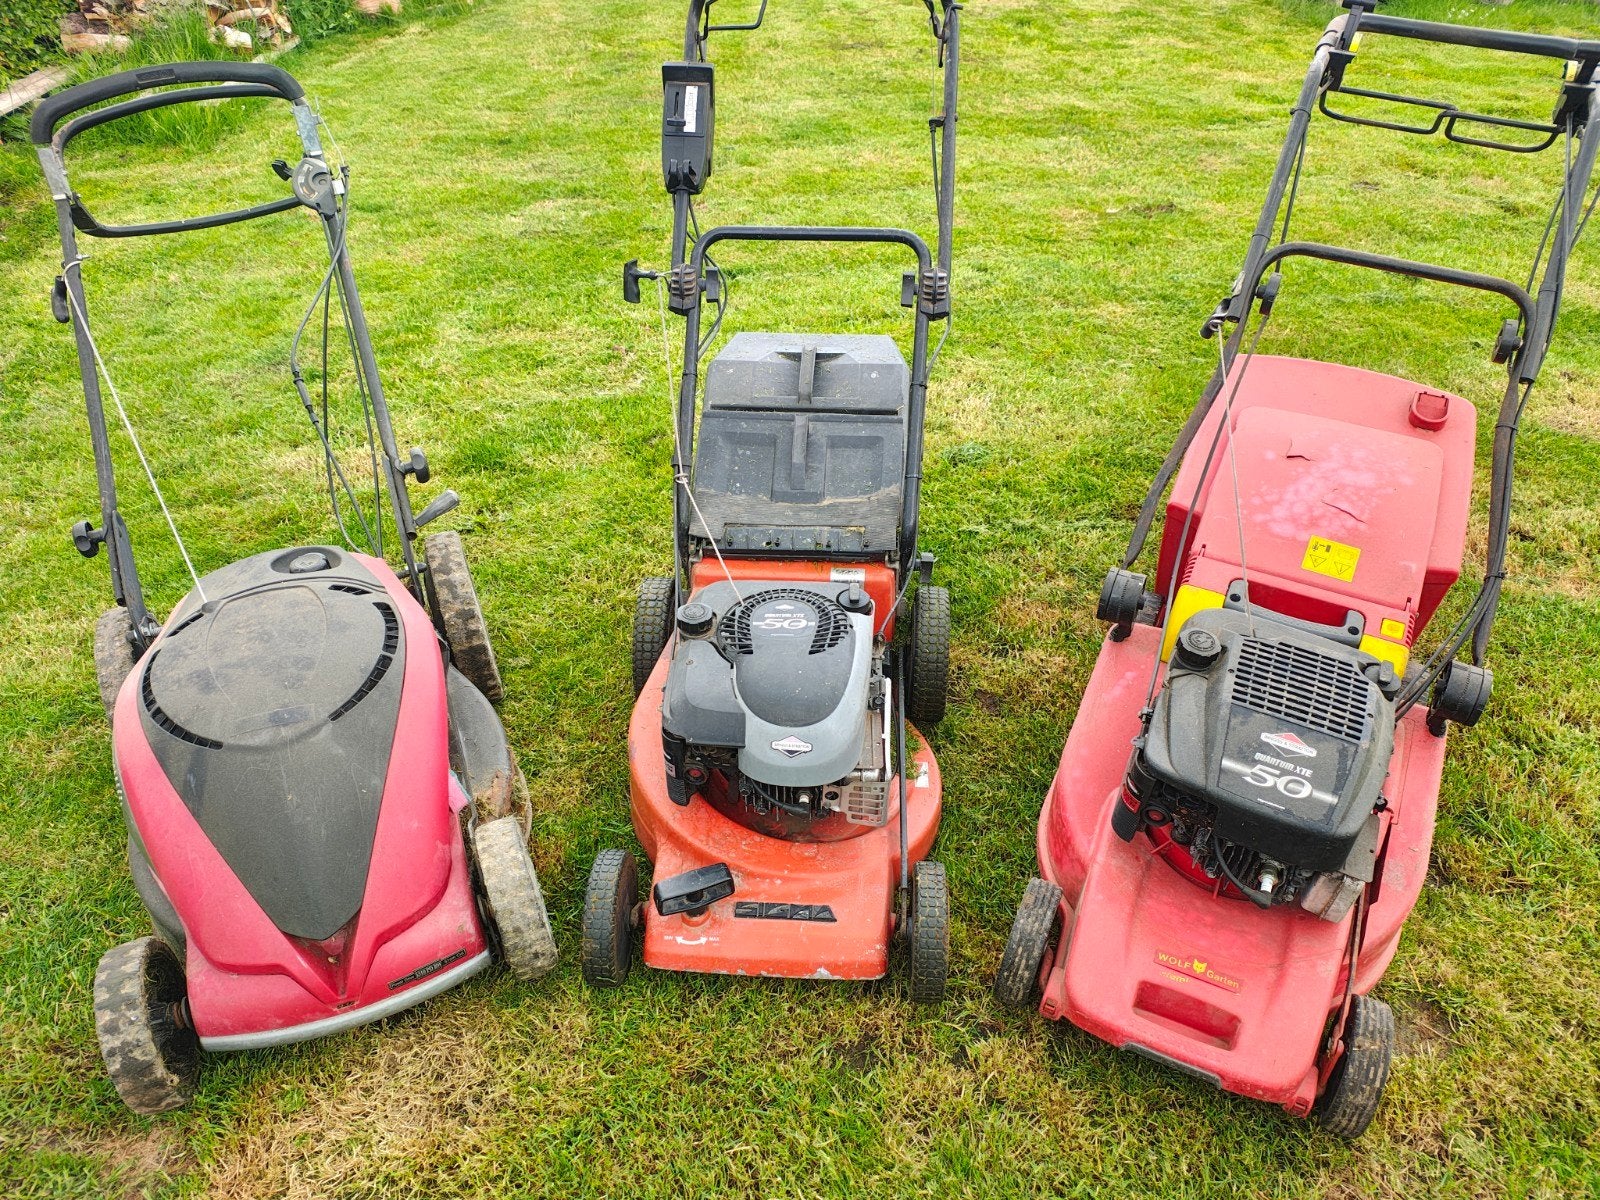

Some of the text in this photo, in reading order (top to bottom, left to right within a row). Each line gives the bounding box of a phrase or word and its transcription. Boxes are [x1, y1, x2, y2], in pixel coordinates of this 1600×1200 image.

[760, 618, 808, 630] 50
[1242, 764, 1313, 799] 50
[1294, 765, 1314, 778] XTE
[1158, 952, 1191, 969] WOLF
[1206, 969, 1240, 989] Garten
